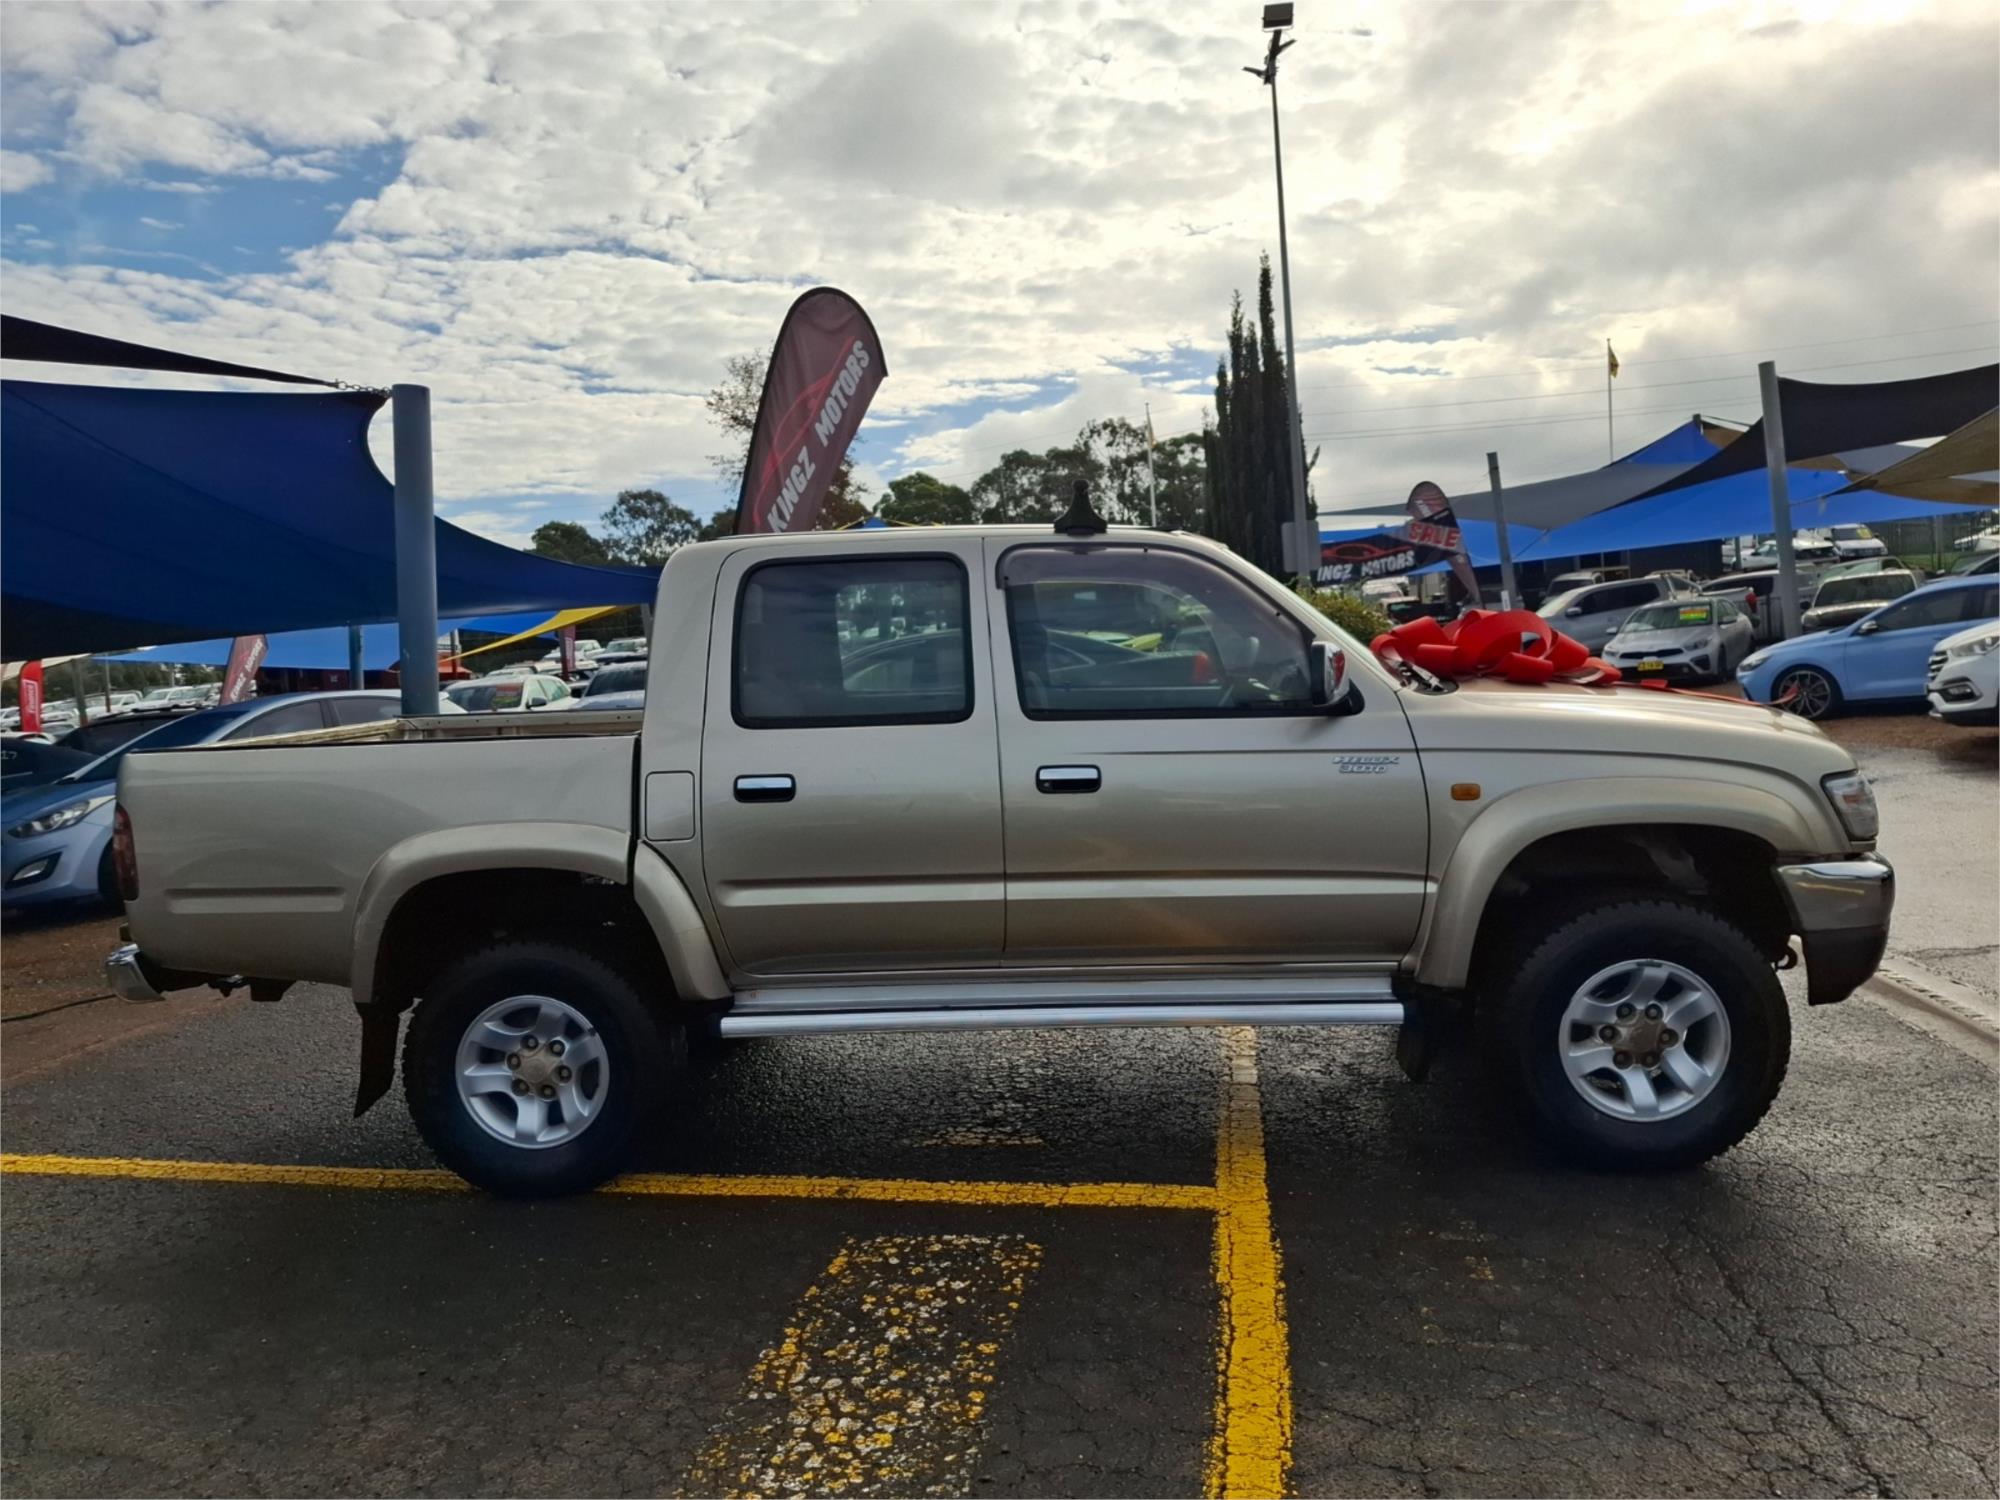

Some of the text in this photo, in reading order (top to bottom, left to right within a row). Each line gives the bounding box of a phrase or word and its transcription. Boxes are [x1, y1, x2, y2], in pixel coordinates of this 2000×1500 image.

[767, 339, 870, 533] KINGZ MOTORS
[1408, 522, 1461, 548] SALE
[1361, 550, 1415, 577] MOTORS
